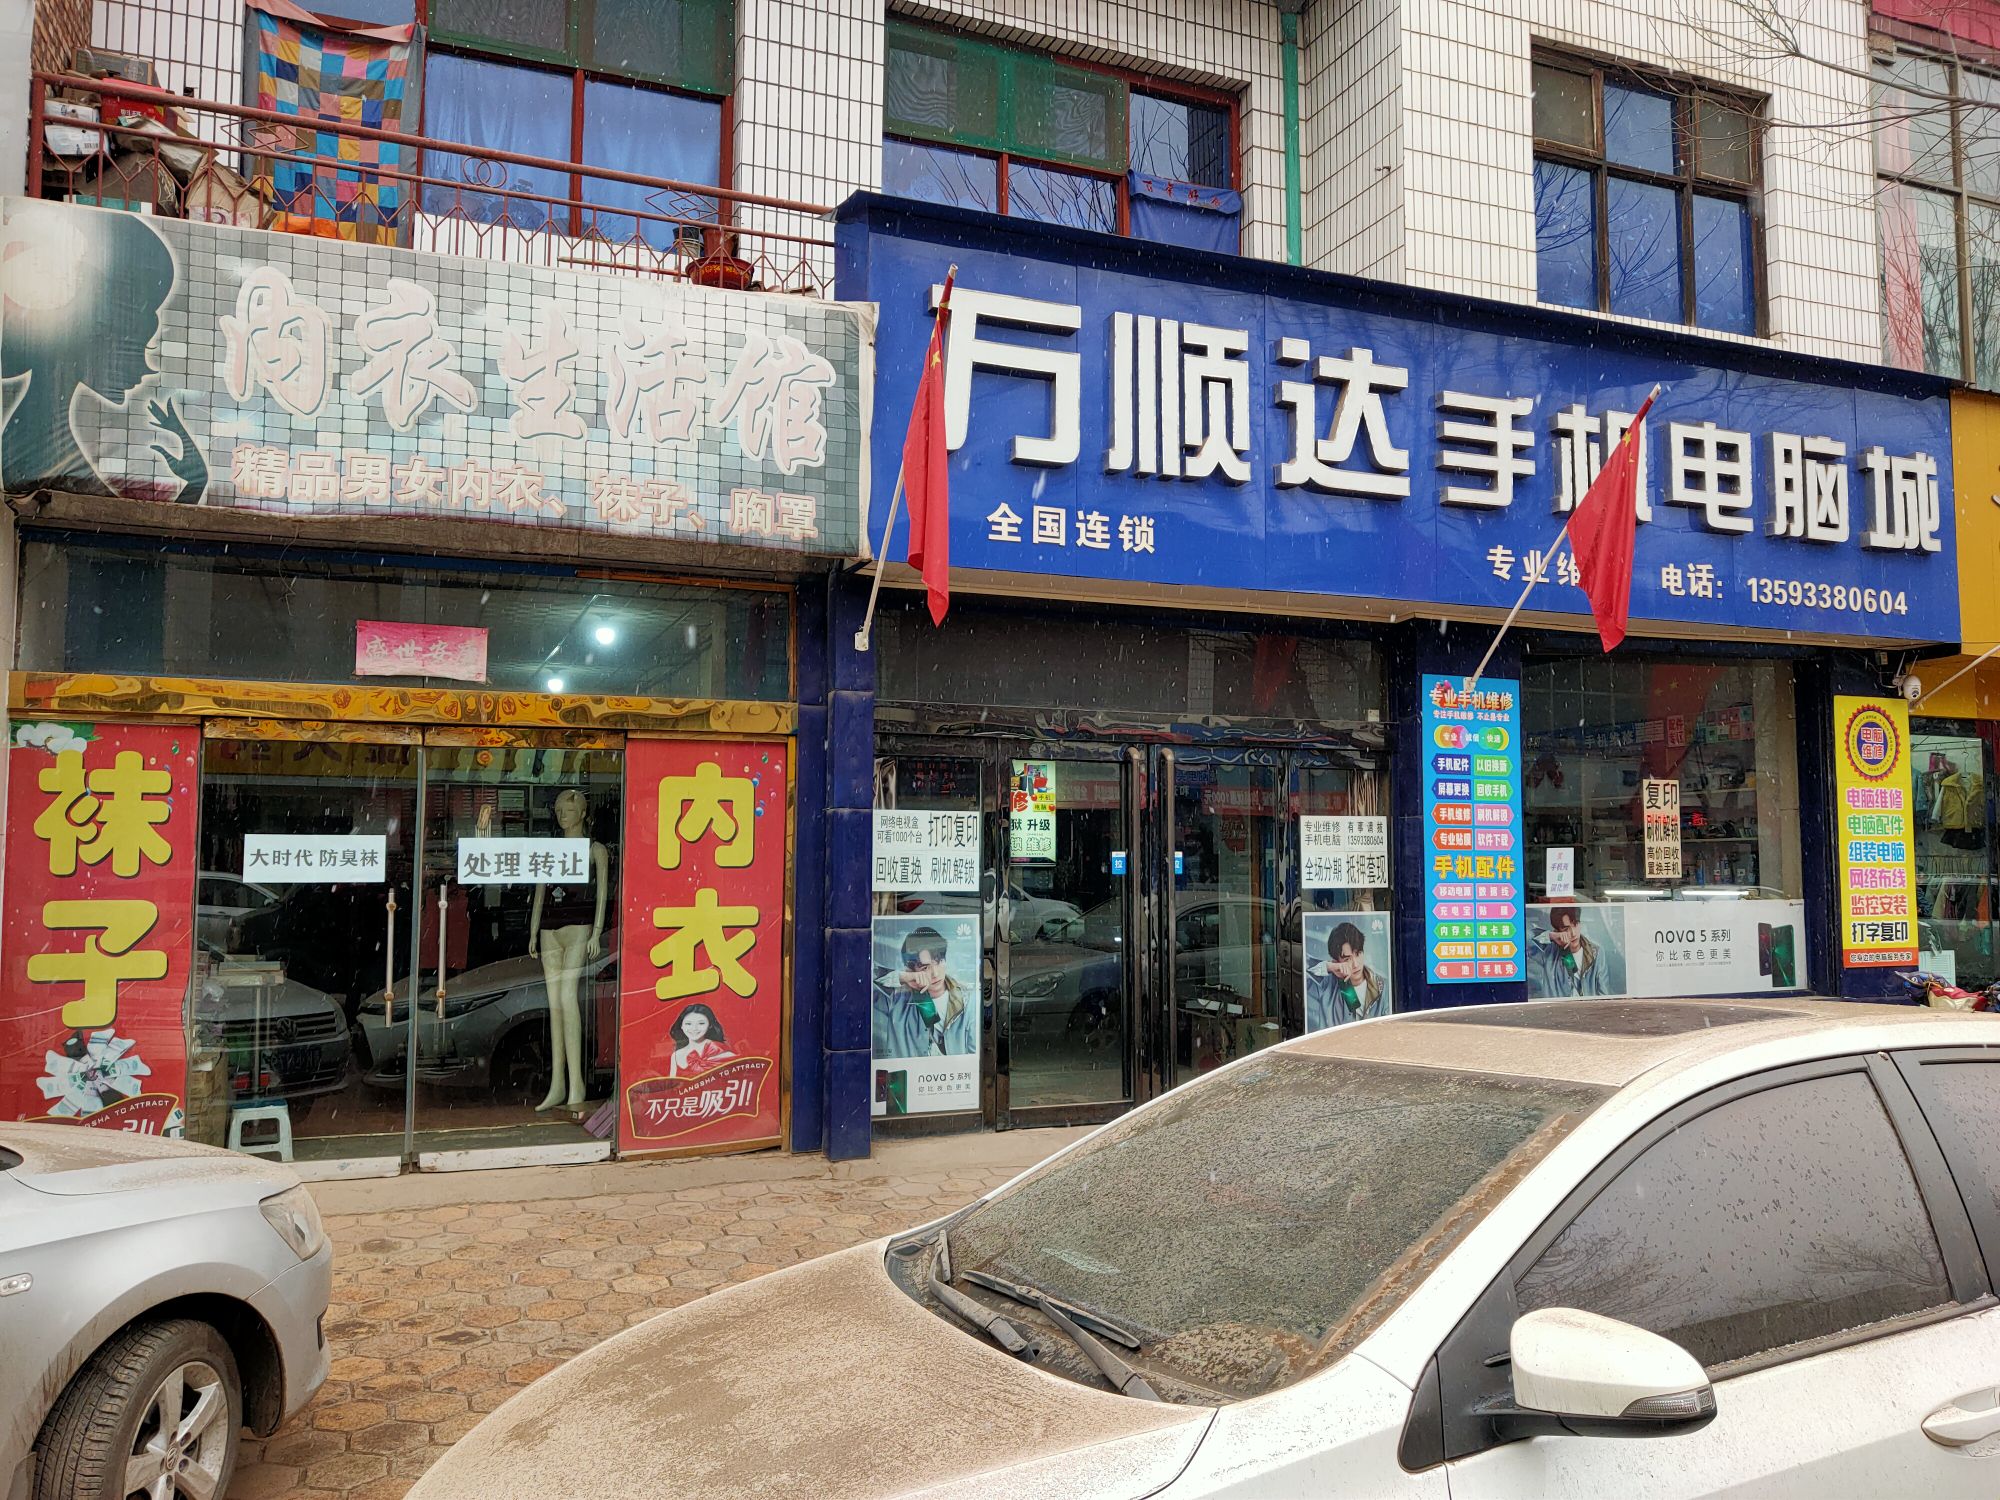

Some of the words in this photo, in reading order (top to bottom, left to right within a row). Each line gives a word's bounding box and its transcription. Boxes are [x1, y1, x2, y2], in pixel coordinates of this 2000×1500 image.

[221, 267, 835, 474] 内衣生活馆
[929, 284, 1943, 553] 万顺达手机电脑城
[986, 502, 1155, 554] 全国连锁
[1486, 544, 1581, 587] 专业维
[1661, 563, 1724, 599] 电话:
[1747, 577, 1908, 616] 13593380604
[1429, 688, 1513, 710] 专业手机维修
[1861, 728, 1884, 743] 电脑
[1862, 744, 1884, 759] 维修
[1438, 757, 1470, 772] 手机配件
[1477, 784, 1508, 797] 回收手机
[1645, 781, 1678, 810] 复印
[1847, 787, 1903, 809] 电脑维修
[880, 815, 919, 829] 网络电视盒
[1440, 808, 1471, 821] 手机维修
[928, 812, 978, 847] 打印复印
[1027, 819, 1050, 831] 升级
[1304, 820, 1341, 833] 专业维修
[1647, 815, 1679, 843] 刷机解锁
[1848, 815, 1904, 835] 电脑配件
[877, 830, 922, 844] 可看1000个台
[1026, 837, 1052, 852] 维修
[1304, 834, 1341, 846] 手机电脑
[1347, 835, 1384, 846] 13593380604
[250, 848, 313, 867] 大时代
[319, 848, 379, 867] 防臭袜
[1647, 846, 1679, 861] 高价回收
[1848, 841, 1905, 862] 组装电脑
[463, 851, 521, 877] 处理
[529, 851, 584, 877] 转让
[876, 856, 922, 884] 回收置换
[930, 856, 975, 885] 刷机解锁
[1305, 857, 1342, 882] 全场分期
[1346, 853, 1387, 885] 抵押套现
[1433, 855, 1515, 879] 手机配件
[1647, 861, 1680, 875] 置换手机
[649, 762, 759, 999] 内衣
[1850, 868, 1906, 888] 网络布线
[27, 750, 172, 1027] 袜子
[1851, 895, 1907, 915] 监控安装
[1655, 929, 1695, 943] nova
[1700, 930, 1706, 942] 5
[1710, 929, 1731, 942] 系列
[1852, 922, 1908, 942] 打字复印
[1656, 948, 1731, 961] 你比夜色更美
[731, 1063, 765, 1073] ATTRACT
[918, 1072, 947, 1083] nova
[115, 1108, 126, 1117] TO
[130, 1100, 169, 1112] ATTRACT
